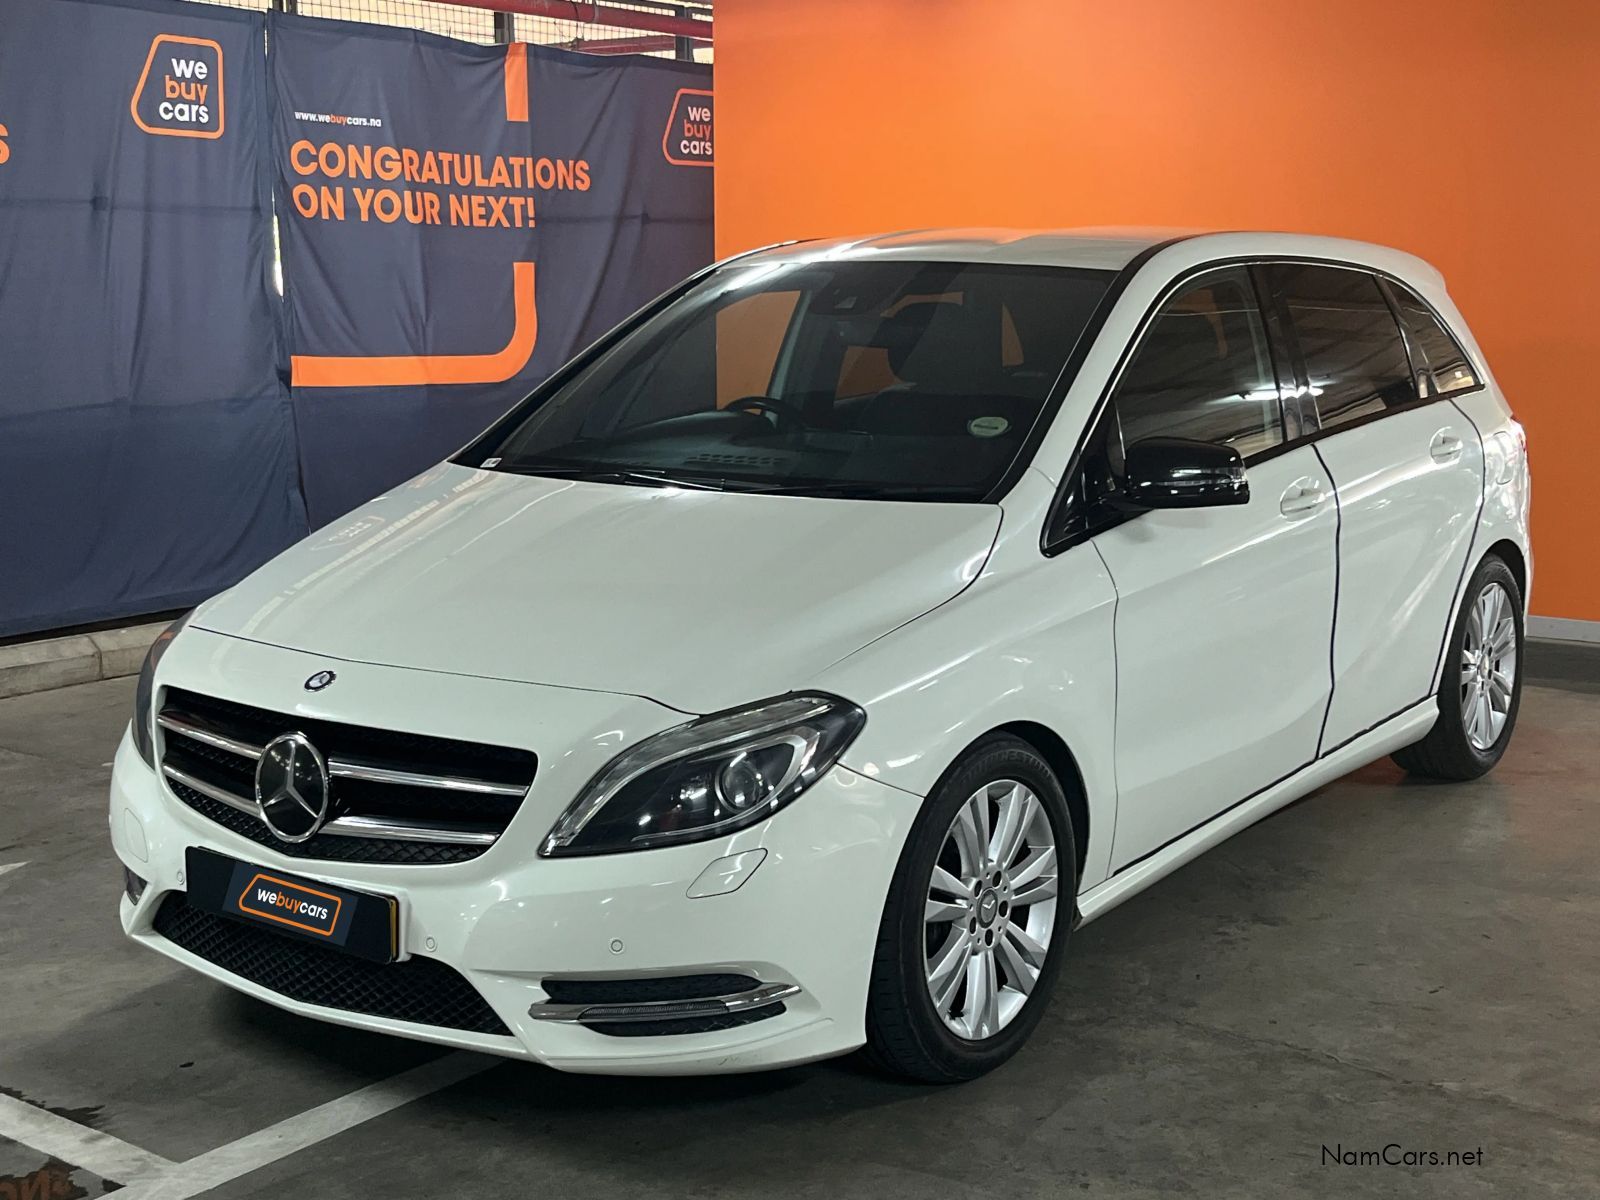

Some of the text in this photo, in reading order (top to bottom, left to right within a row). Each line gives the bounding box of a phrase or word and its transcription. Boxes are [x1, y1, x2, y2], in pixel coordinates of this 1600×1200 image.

[171, 58, 208, 80] we
[164, 74, 208, 105] buy
[158, 101, 209, 124] cars
[294, 111, 382, 127] www.webuycars.na
[687, 106, 711, 122] we
[683, 119, 711, 141] buy
[680, 140, 713, 155] cars
[290, 139, 591, 192] CONGRATULATIONS
[292, 183, 536, 228] ON YOUR NEXT!
[257, 888, 328, 920] webuycars
